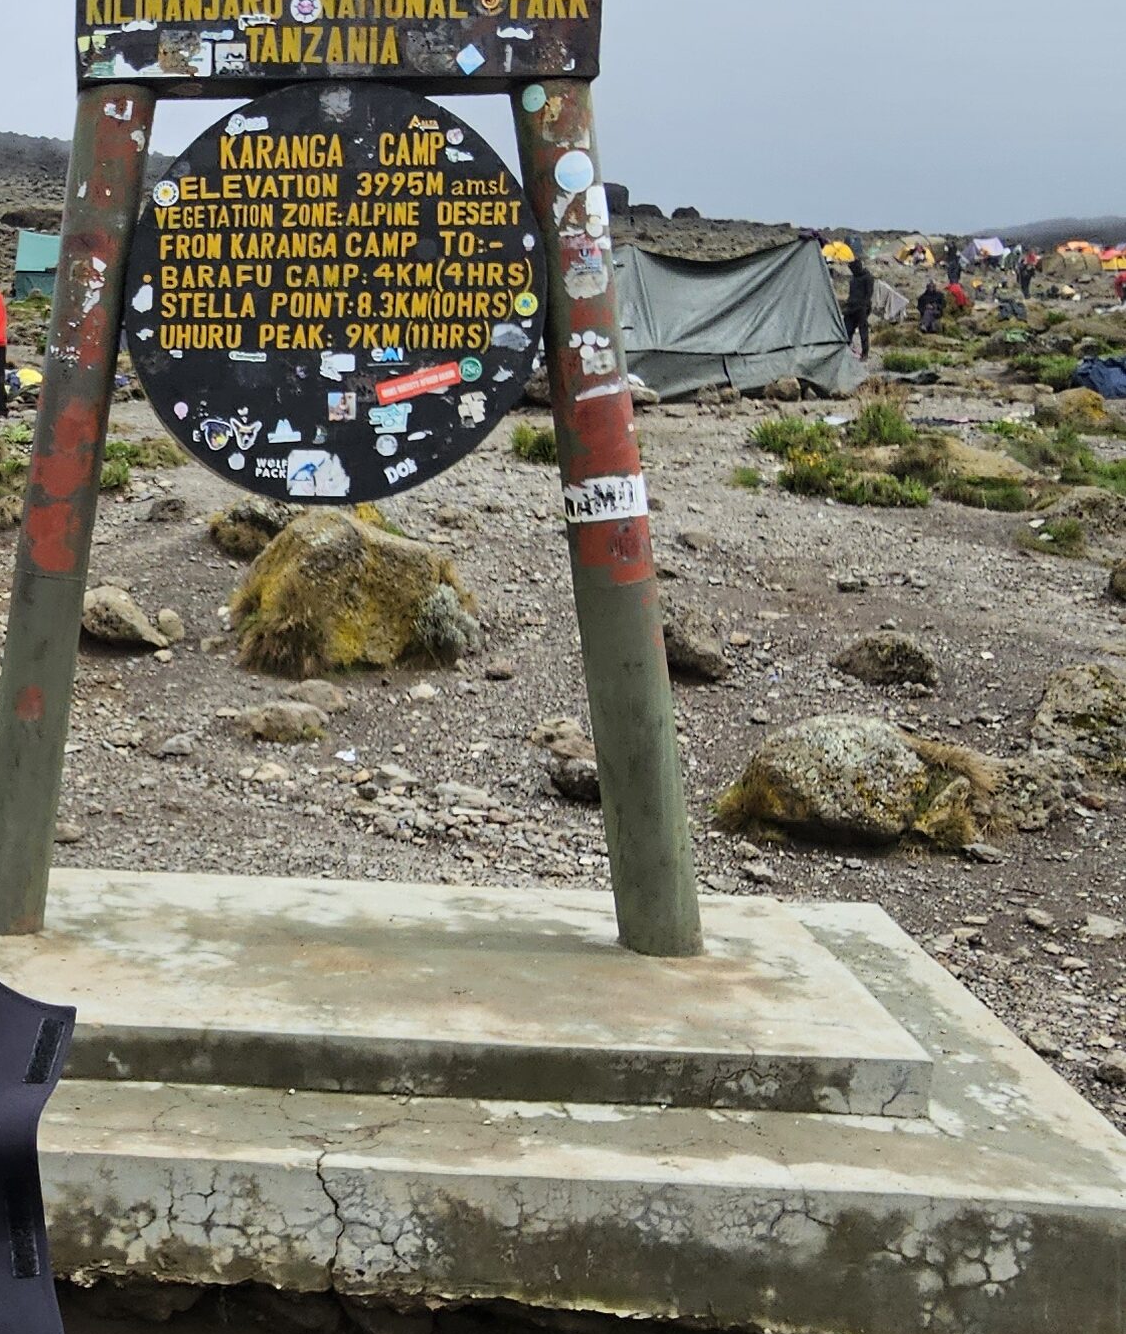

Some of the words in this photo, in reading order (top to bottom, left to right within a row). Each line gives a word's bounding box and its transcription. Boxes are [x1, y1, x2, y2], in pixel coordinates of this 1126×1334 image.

[245, 25, 399, 65] TANZANIA
[219, 133, 344, 170] KARANGA
[378, 131, 446, 167] CAMP
[179, 173, 339, 200] ELEVATION
[356, 171, 444, 197] 3995M
[450, 171, 510, 196] amsl
[154, 203, 274, 230] VEGETATION
[436, 200, 522, 226] DESERT
[159, 233, 222, 261] FROM
[230, 232, 338, 260] KARANGA
[345, 231, 418, 258] CAMP
[161, 264, 273, 290] BARAFU
[160, 292, 257, 319] STELLA
[159, 323, 243, 350] UHURU
[255, 467, 287, 479] PACK
[256, 457, 288, 469] WOLF
